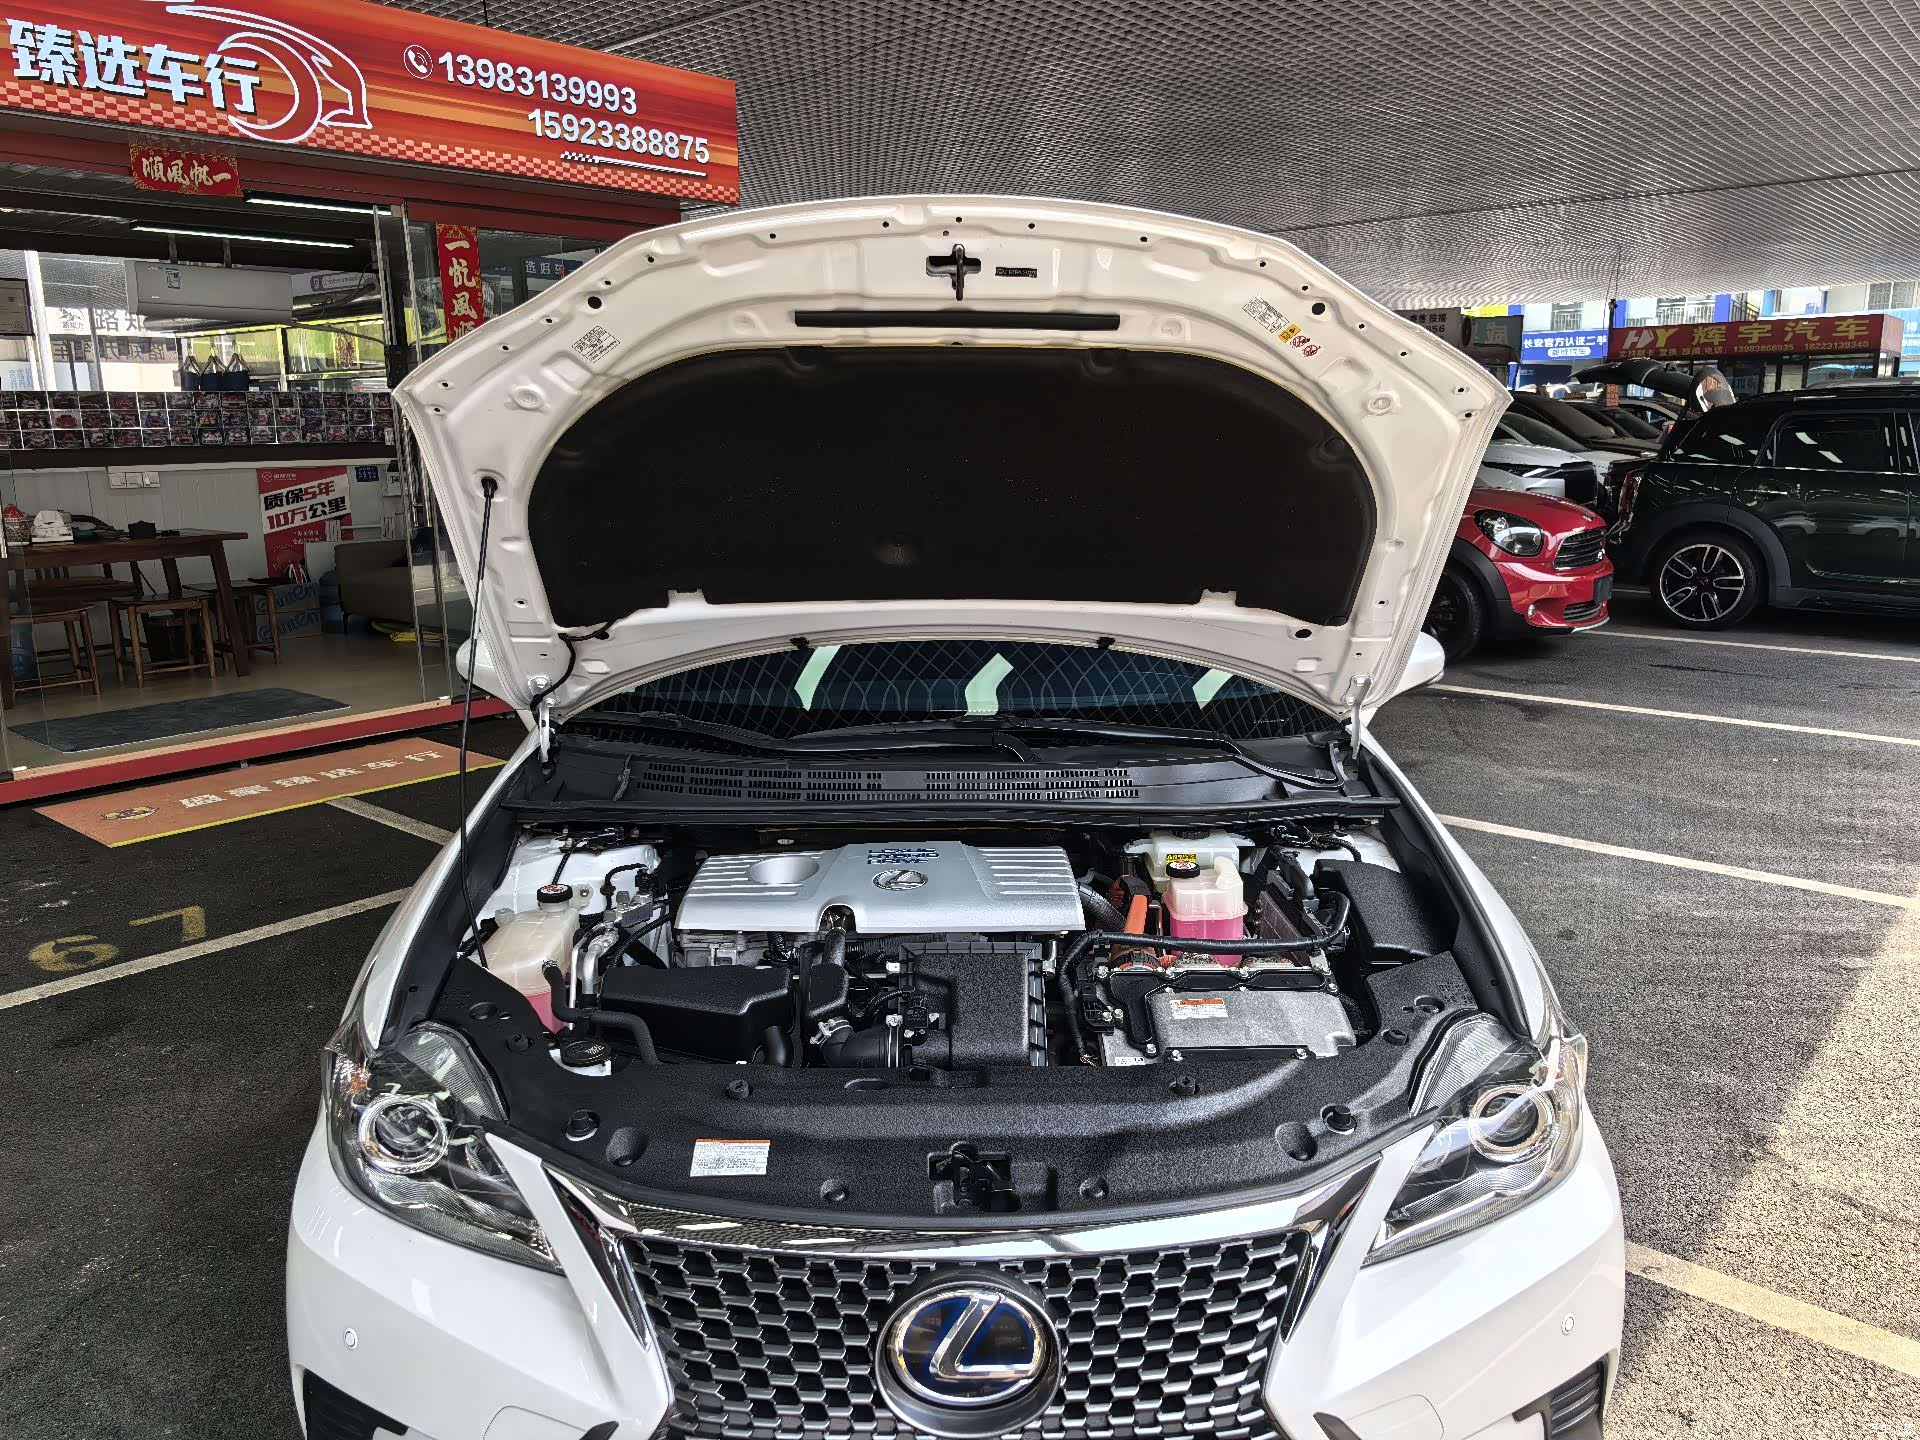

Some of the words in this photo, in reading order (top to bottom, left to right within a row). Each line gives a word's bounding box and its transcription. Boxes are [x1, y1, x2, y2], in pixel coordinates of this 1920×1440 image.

[5, 18, 261, 115] 臻选车行
[437, 51, 638, 115] 13983139993
[527, 108, 711, 165] 15923388875
[1692, 319, 1869, 345] 辉宇汽车
[264, 480, 336, 512] 质保5年
[267, 496, 347, 530] 10万公里
